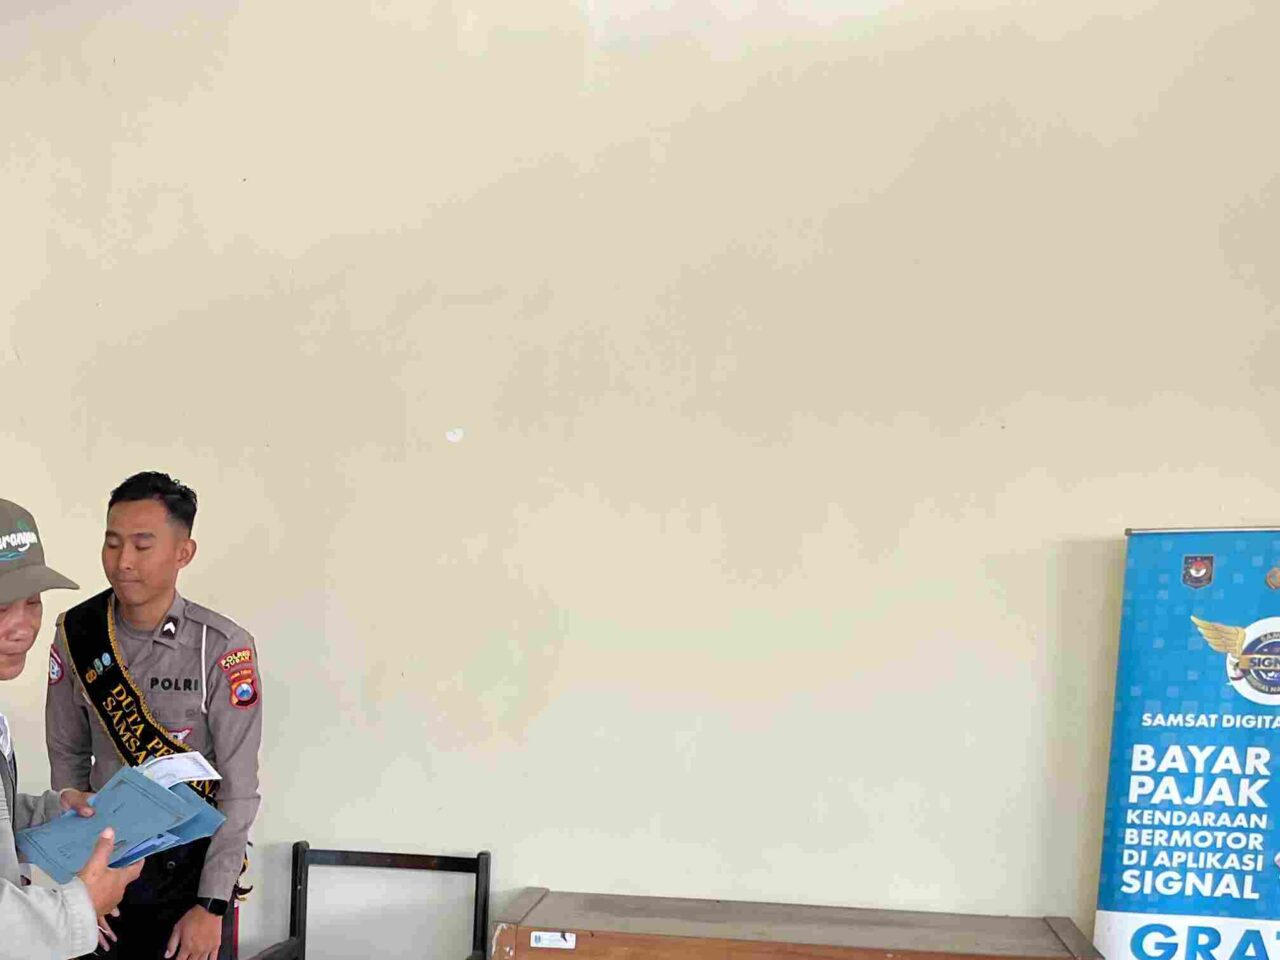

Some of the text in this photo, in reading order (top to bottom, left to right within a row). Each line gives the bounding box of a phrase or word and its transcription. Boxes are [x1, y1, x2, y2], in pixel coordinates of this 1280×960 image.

[150, 677, 199, 691] POLRI
[112, 683, 145, 738] DUTA
[1141, 712, 1219, 729] SAMSAT
[1131, 743, 1271, 776] BAYAR
[1128, 775, 1269, 808] PAJAK
[1126, 809, 1268, 829] KENDARAAN
[1124, 827, 1264, 851] BERMOTOR
[1122, 849, 1264, 872] DI APLIKASI
[1121, 868, 1260, 900] SIGNAL
